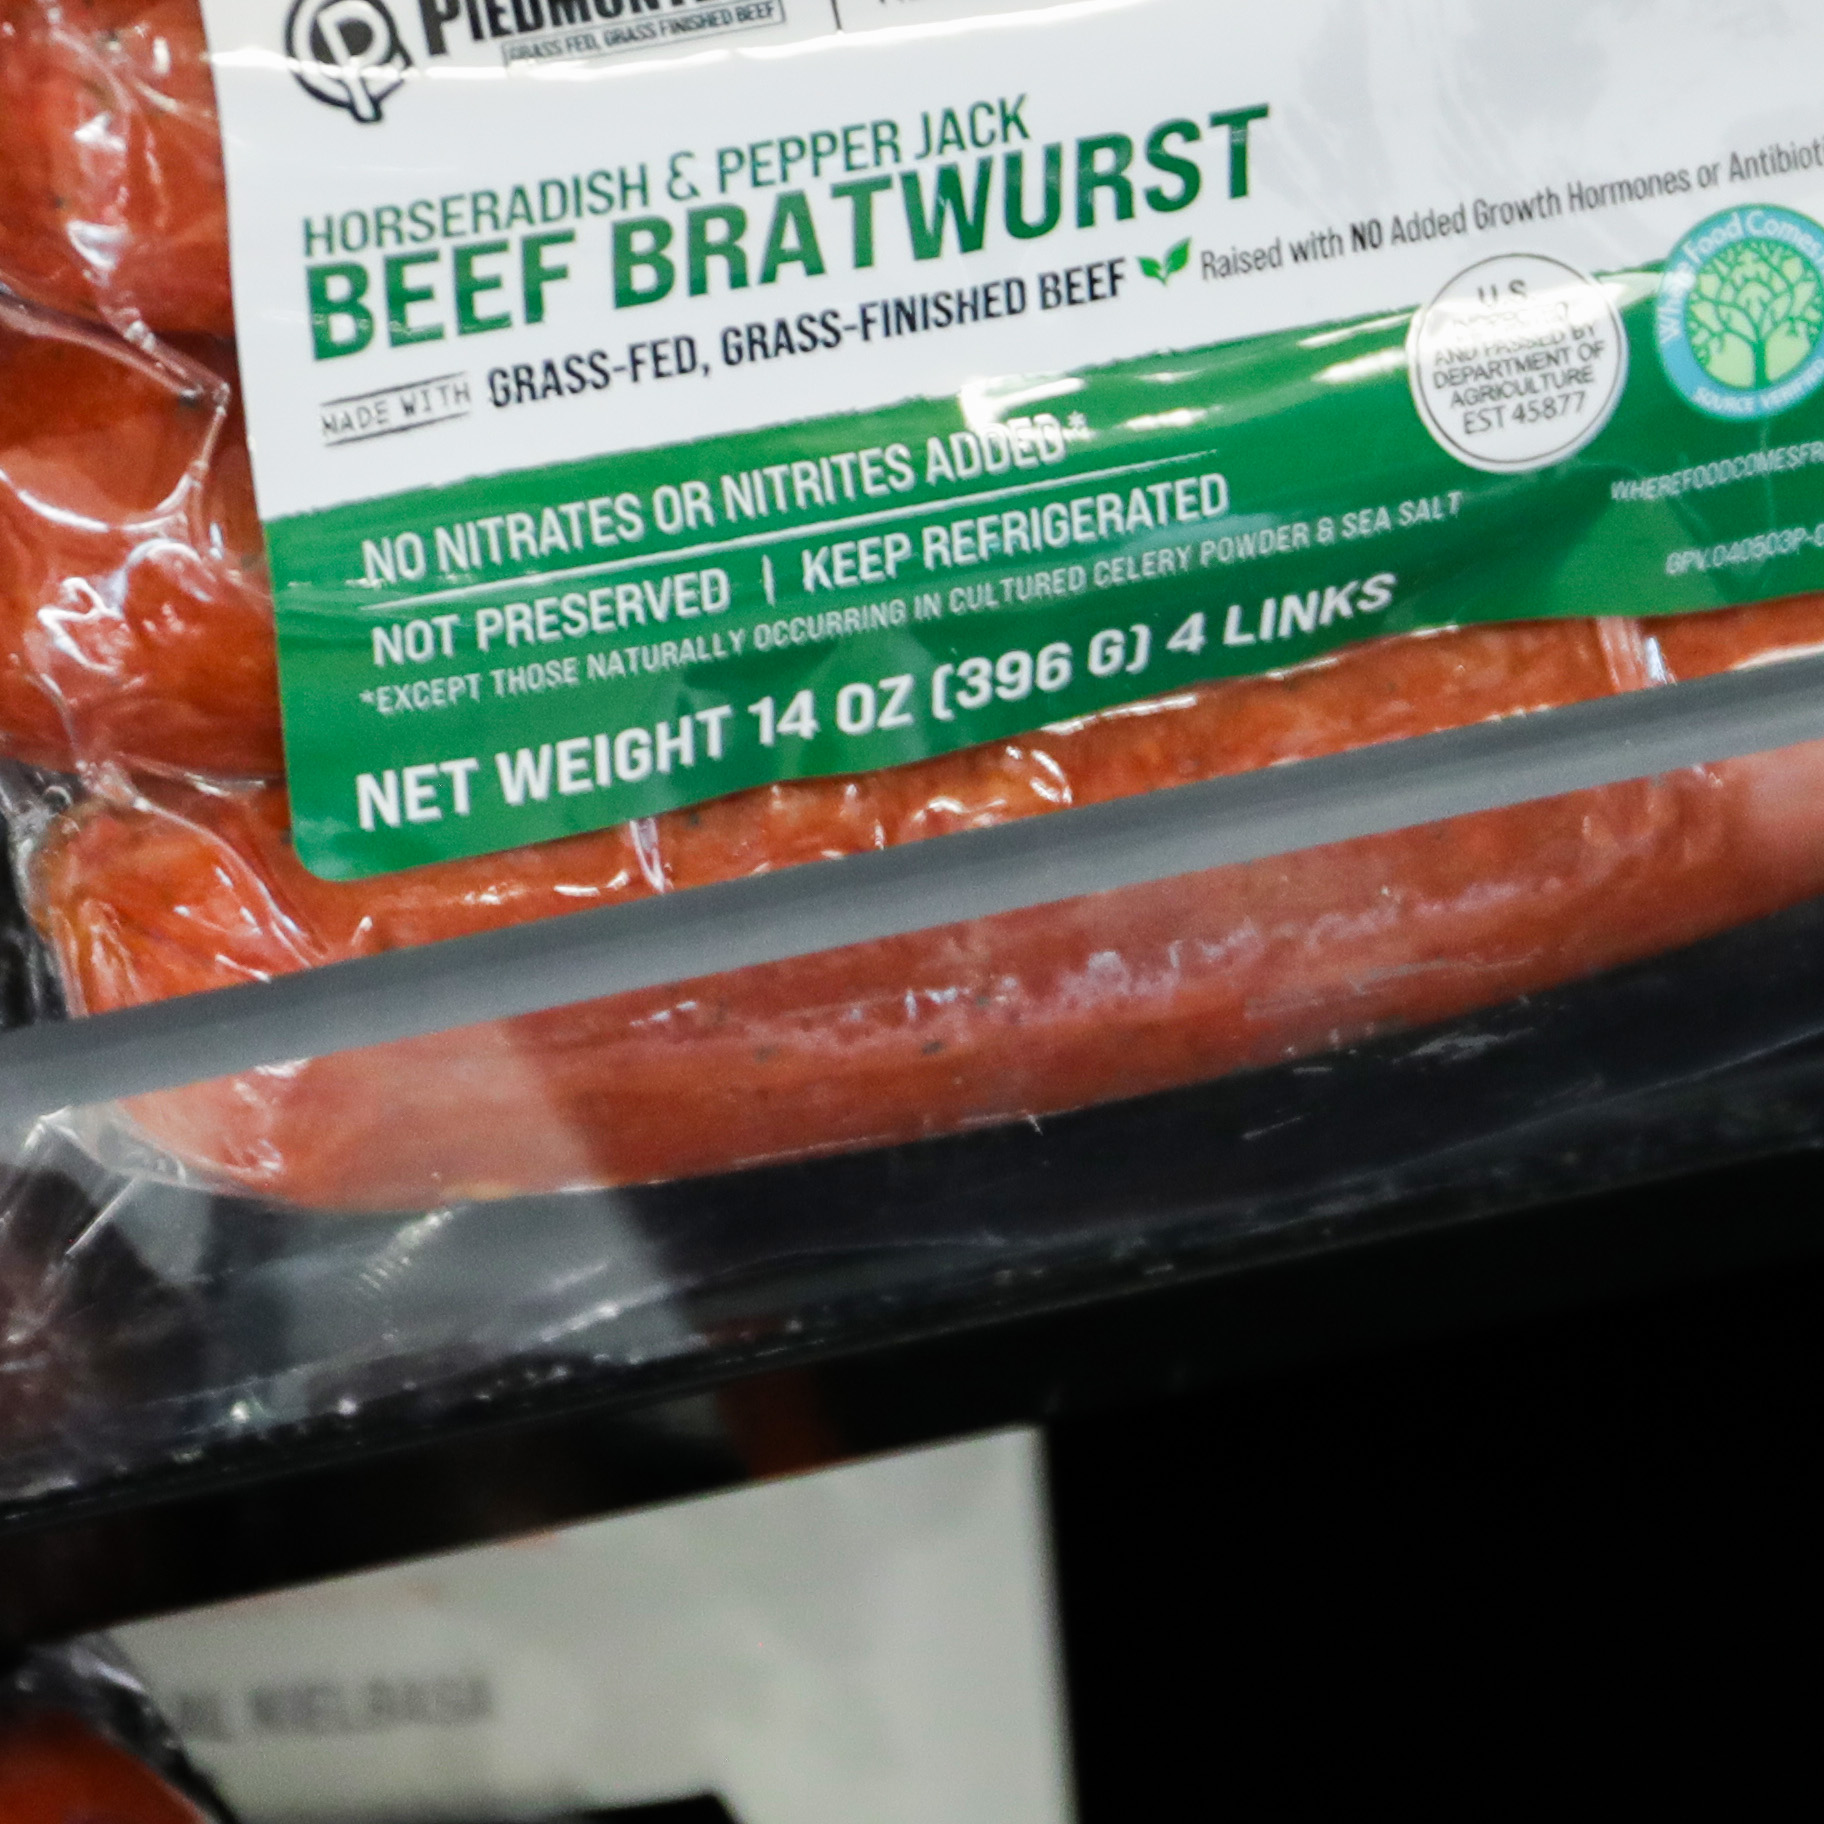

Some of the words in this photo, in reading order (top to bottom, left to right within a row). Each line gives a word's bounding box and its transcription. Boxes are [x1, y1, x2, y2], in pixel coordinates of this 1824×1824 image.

[302, 162, 650, 259] HORSERADISH
[666, 149, 701, 203] &
[716, 117, 902, 195] PEPPER
[915, 92, 1033, 163] JACK
[305, 228, 577, 362] BEEF
[610, 102, 1272, 311] BRATWURST
[1200, 236, 1285, 282] Raised
[1289, 224, 1346, 266] with
[1350, 218, 1385, 255] NO
[1389, 204, 1469, 246] Added
[1473, 189, 1562, 233] Growth
[1567, 168, 1691, 214] Hormones
[1695, 162, 1721, 190] or
[1683, 211, 1744, 266] Food
[321, 399, 391, 438] MADE
[401, 380, 473, 419] WITH
[486, 333, 713, 409] GRASS-FED,
[720, 274, 1028, 368] GRASS-FINISHED
[1038, 256, 1128, 314] BEEF
[1432, 346, 1572, 390] DEPARTMENT
[1577, 339, 1606, 362] OF
[1450, 364, 1596, 409] AGRICULTURE
[1463, 404, 1506, 435] EST
[1511, 390, 1587, 425] 45877
[361, 532, 427, 584] NO
[433, 491, 645, 574] NITRATES
[652, 480, 718, 537] OR
[721, 441, 917, 523] NITRITES
[371, 613, 462, 669] NOT
[475, 566, 732, 654] PRESERVED
[800, 529, 914, 594] KEEP
[921, 472, 1232, 573] REFRIGERATED
[492, 656, 579, 700] THOSE
[586, 626, 749, 679] NATURALLY
[752, 596, 908, 653] OCCURRING
[914, 590, 945, 621] IN
[947, 563, 1088, 615] CULTURED
[1091, 545, 1195, 589] CELERY
[1199, 524, 1313, 567] POWDER
[1316, 515, 1338, 544] &
[1341, 503, 1395, 538] SEA
[1397, 489, 1467, 525] SALT
[355, 757, 480, 833] NET
[494, 703, 734, 808] WEIGHT
[746, 688, 821, 748] 14
[834, 673, 919, 737] OZ
[930, 640, 1075, 722] (396
[1086, 623, 1155, 679] G)
[1165, 609, 1211, 655] 4
[1221, 570, 1400, 647] LINKS
